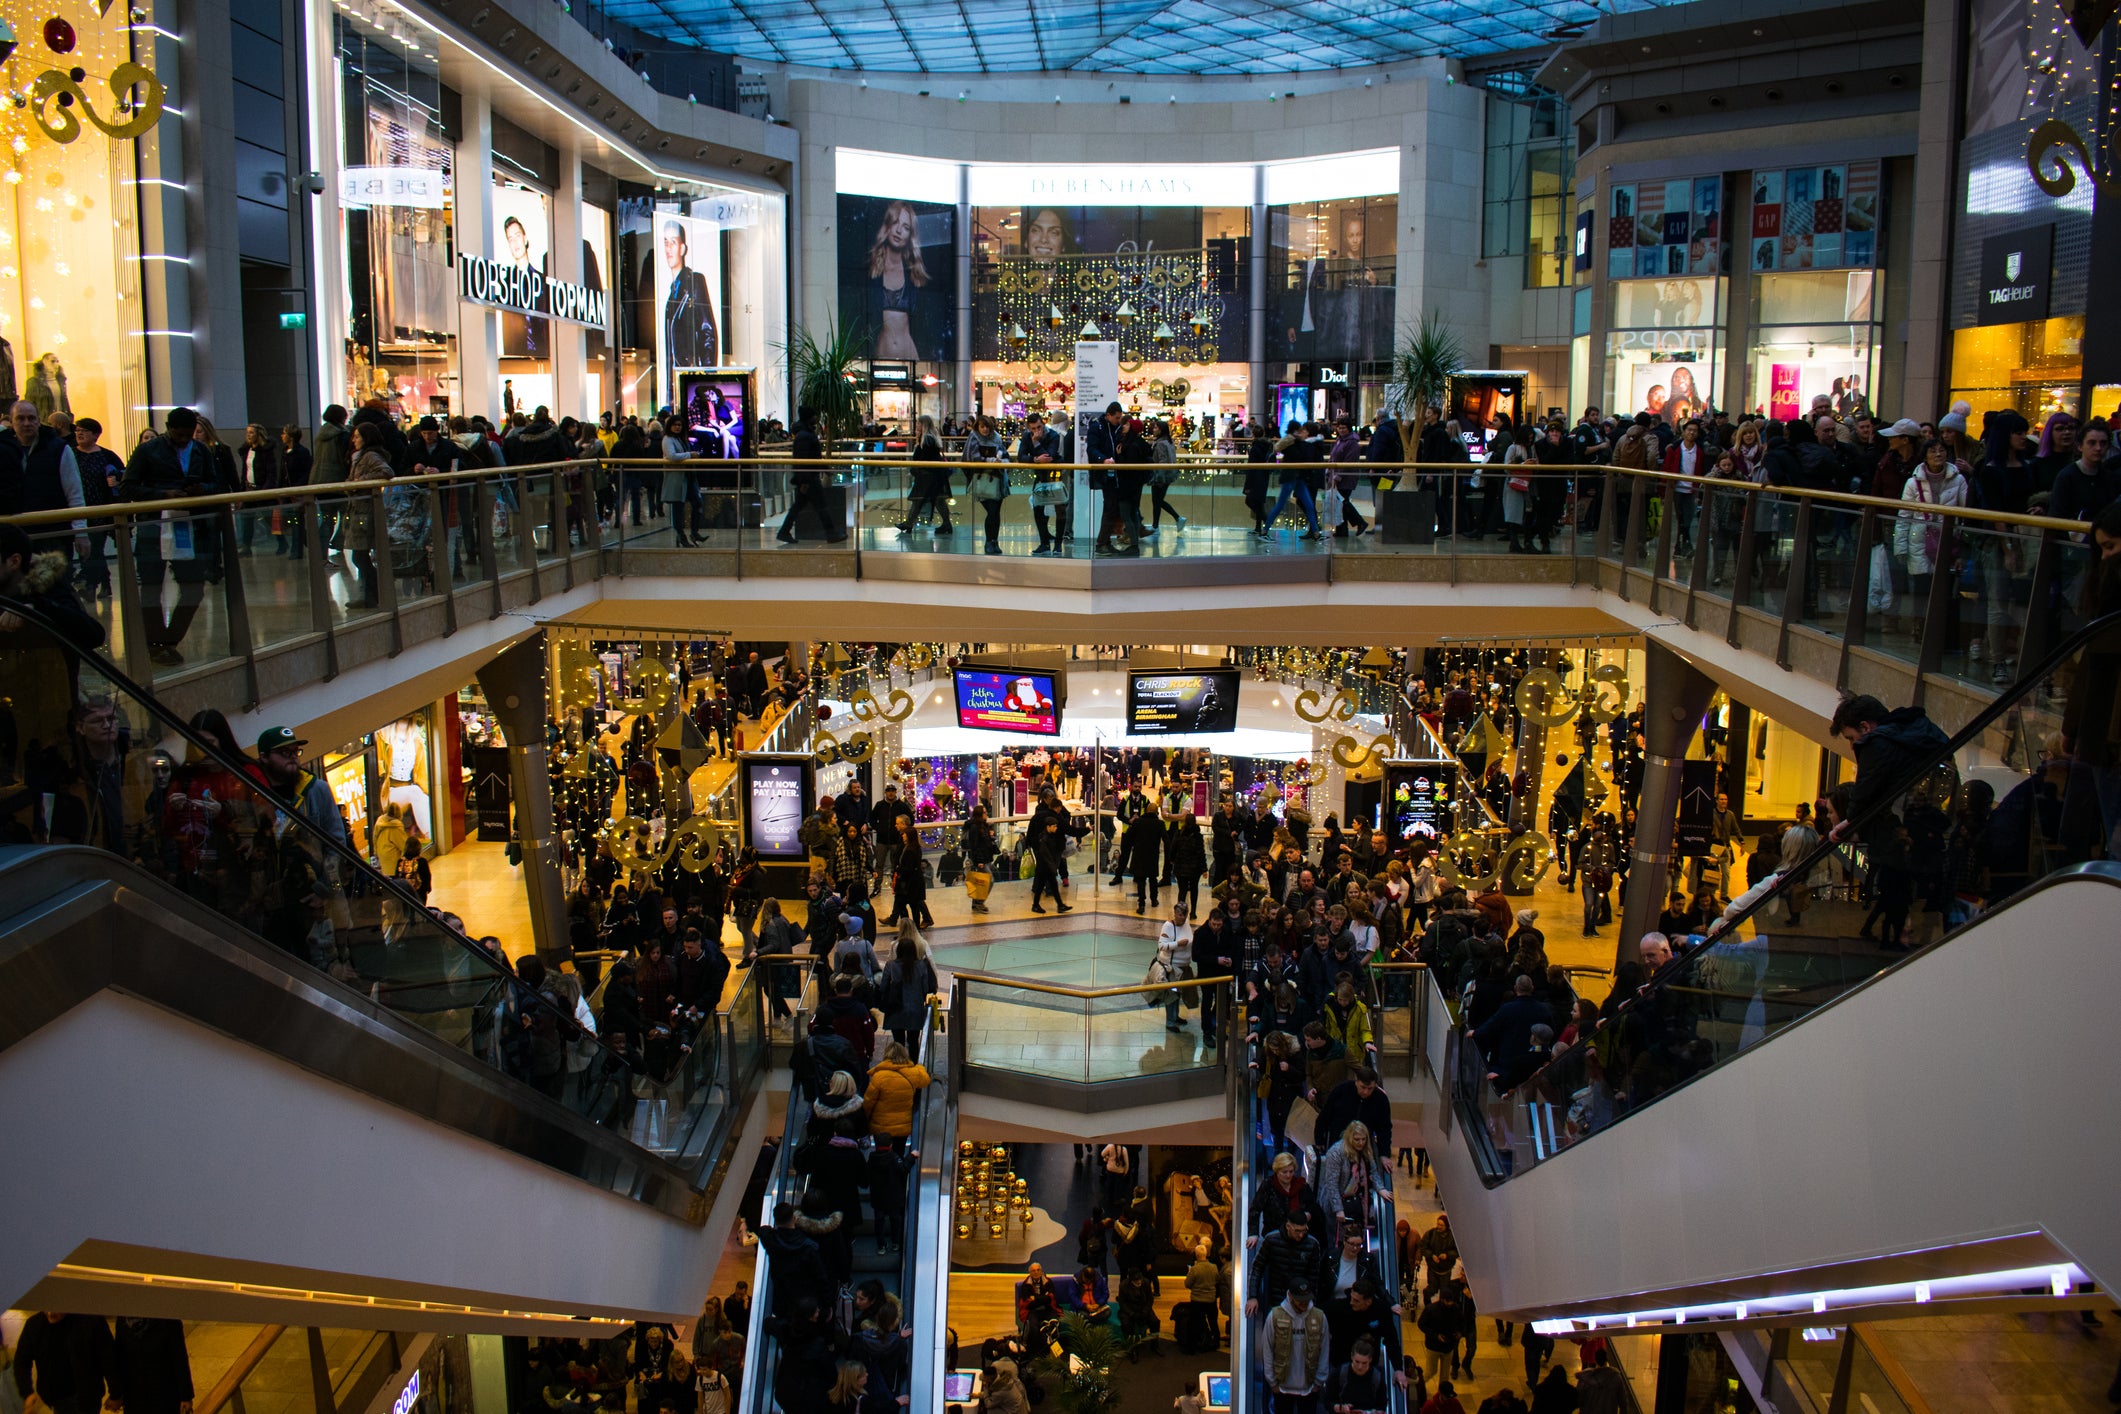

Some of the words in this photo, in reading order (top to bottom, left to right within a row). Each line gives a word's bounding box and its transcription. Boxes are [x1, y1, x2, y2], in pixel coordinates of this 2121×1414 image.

[1031, 178, 1192, 194] DEBENHAMS
[1670, 221, 1686, 236] GAP
[1758, 214, 1777, 229] GAP
[462, 251, 543, 311] TOPSHOP
[545, 275, 607, 327] TOPMAN
[1109, 344, 1116, 353] 2
[1320, 367, 1348, 383] Dior
[1136, 680, 1168, 690] CHRIS
[1169, 678, 1203, 689] ROCK
[822, 765, 847, 785] NEW
[753, 780, 775, 789] PLAY
[776, 780, 799, 790] NOW,
[753, 788, 771, 797] PAY
[772, 789, 800, 797] LATER.
